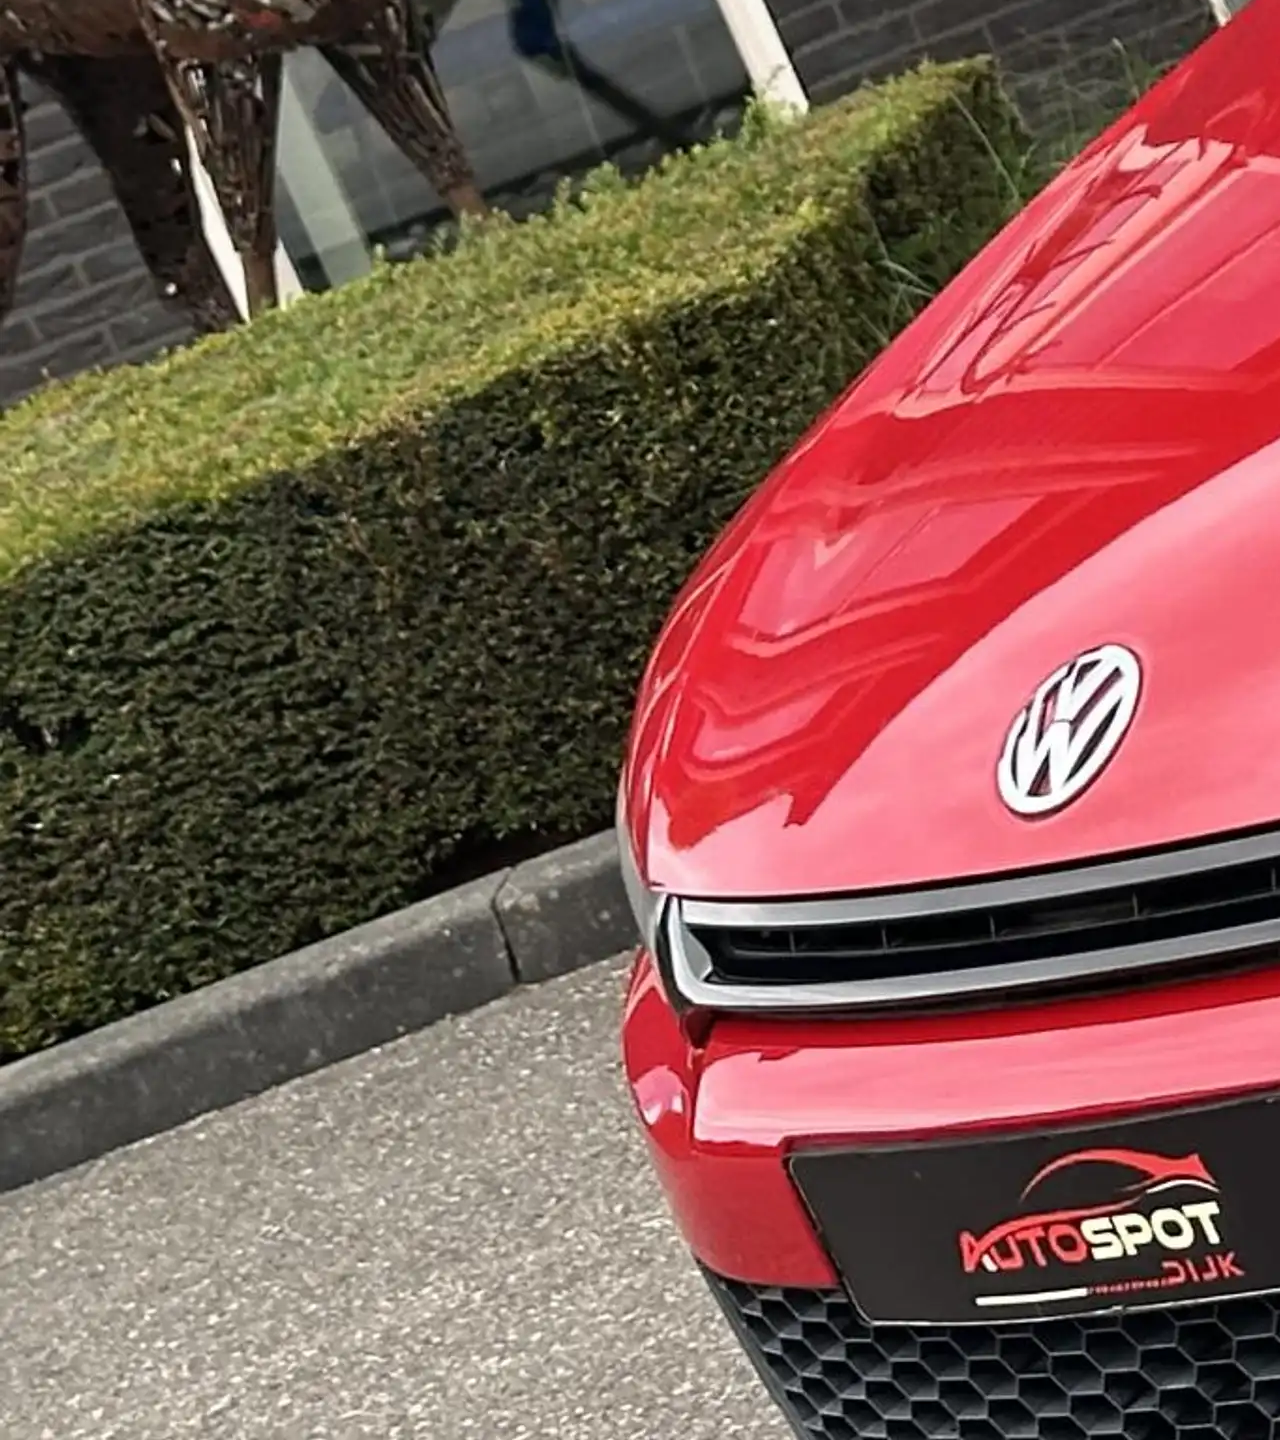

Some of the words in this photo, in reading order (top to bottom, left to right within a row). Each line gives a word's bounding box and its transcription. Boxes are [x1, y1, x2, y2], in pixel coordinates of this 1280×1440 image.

[1001, 647, 1138, 811] VW
[959, 1200, 1220, 1273] AUTOSPOT
[1161, 1252, 1245, 1284] DIJK
